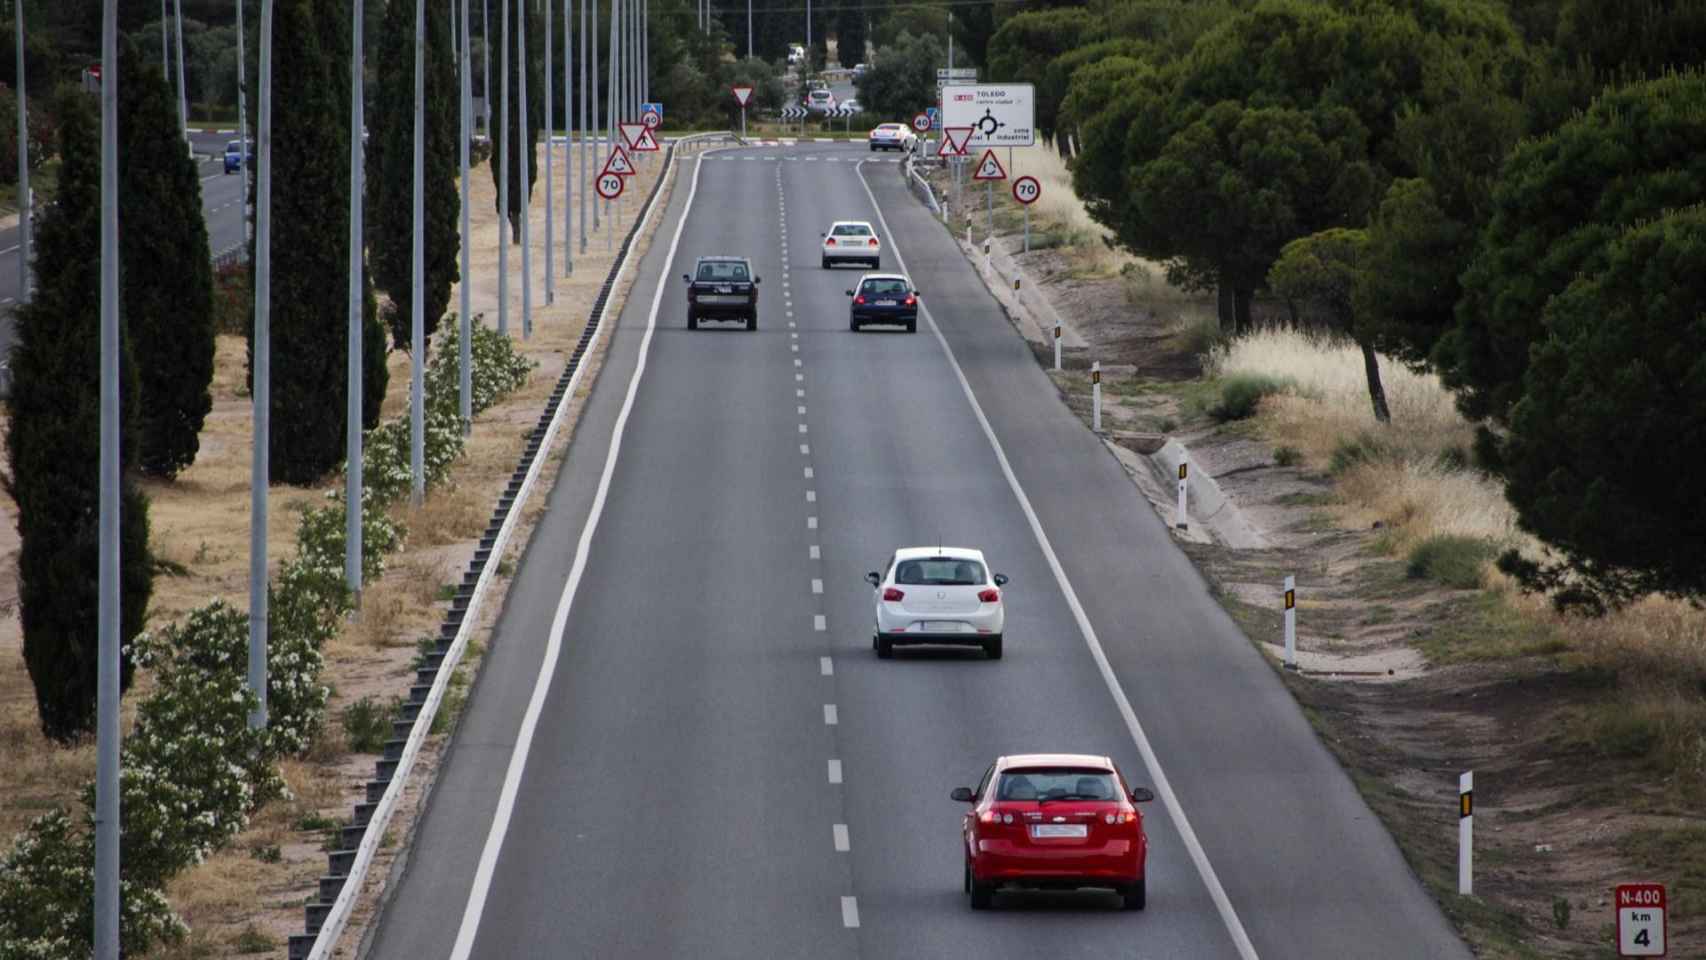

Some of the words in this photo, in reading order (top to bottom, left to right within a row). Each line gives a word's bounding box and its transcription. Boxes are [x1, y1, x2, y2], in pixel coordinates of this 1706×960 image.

[603, 180, 618, 190] 70
[1019, 185, 1035, 195] 70
[1621, 890, 1660, 904] N-400
[1632, 911, 1651, 921] km
[1634, 928, 1650, 947] 4
